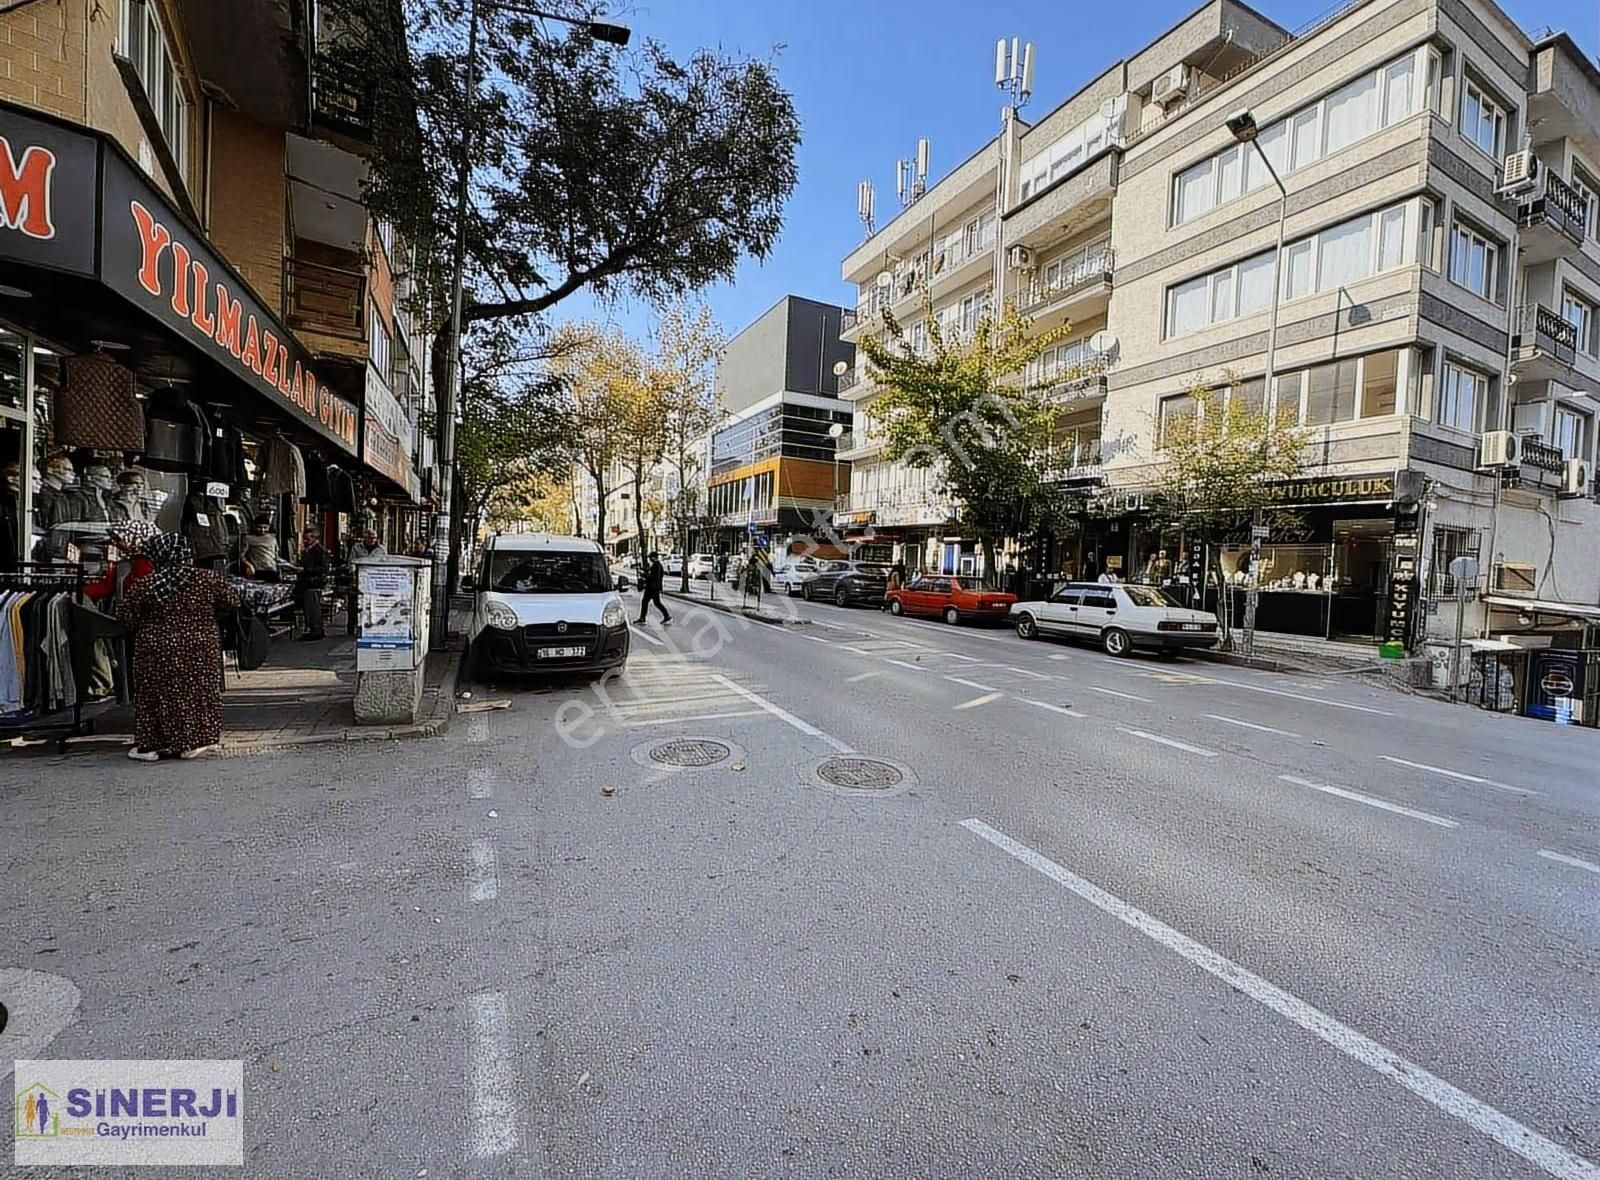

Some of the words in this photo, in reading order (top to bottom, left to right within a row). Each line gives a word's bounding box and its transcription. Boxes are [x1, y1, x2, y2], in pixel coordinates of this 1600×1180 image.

[0, 136, 56, 240] M
[131, 201, 316, 417] YILMAZLAR
[1265, 478, 1391, 500] YUMCULUK
